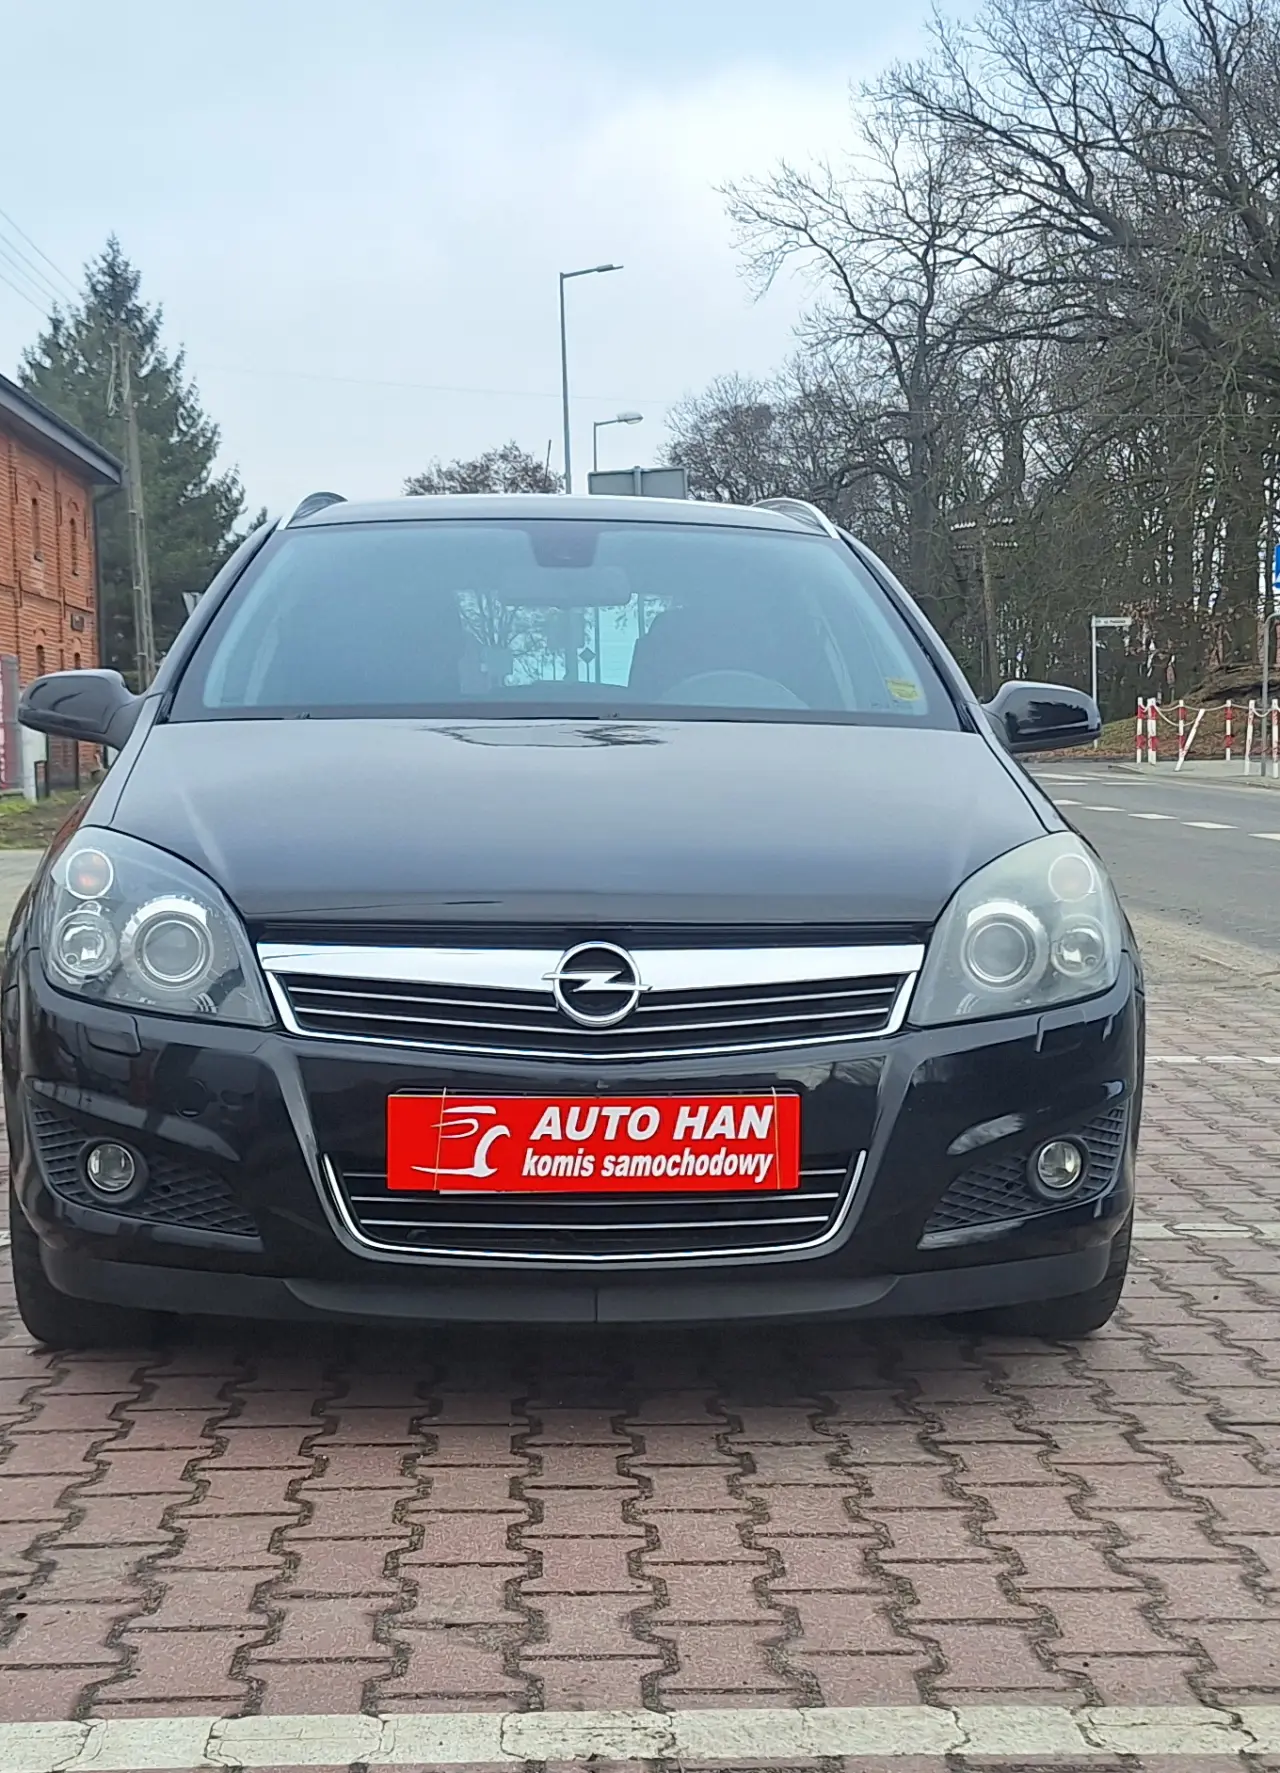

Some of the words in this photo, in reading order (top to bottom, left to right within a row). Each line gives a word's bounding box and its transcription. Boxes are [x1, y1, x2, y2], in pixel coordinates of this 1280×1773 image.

[528, 1105, 661, 1141] AUTO
[672, 1104, 774, 1140] HAN
[521, 1147, 596, 1178] komis
[600, 1146, 774, 1184] samochodowy
